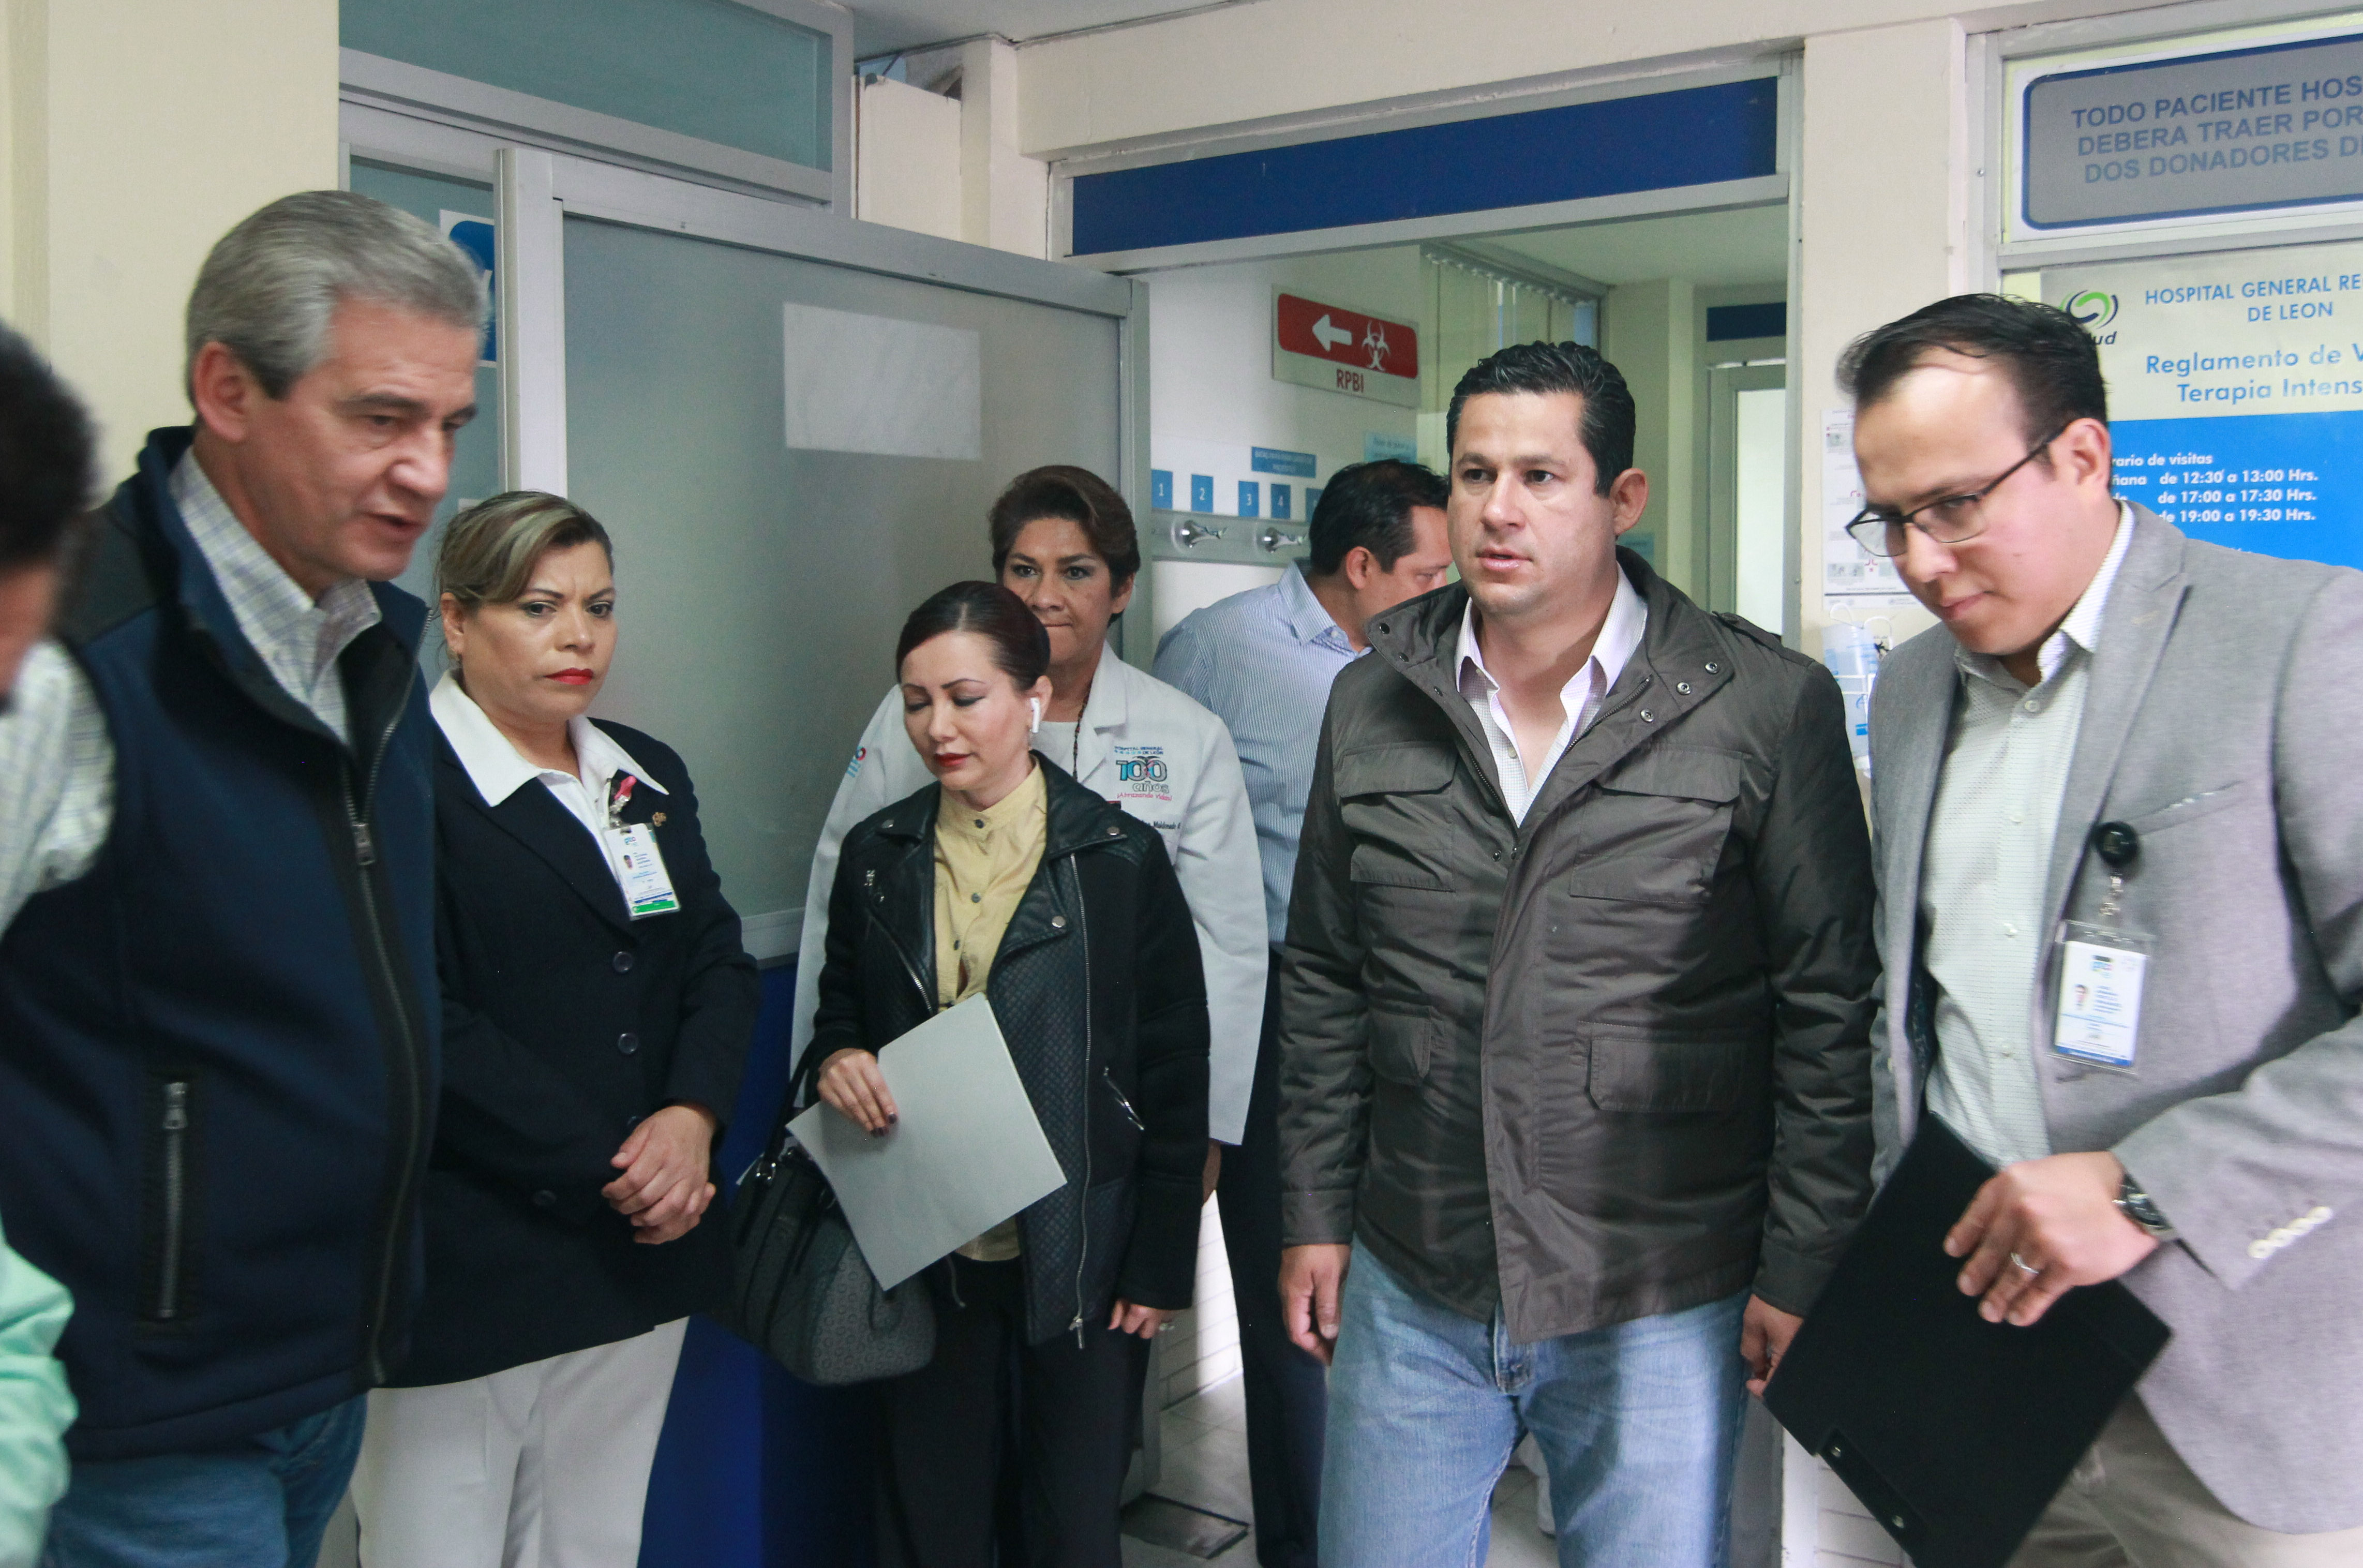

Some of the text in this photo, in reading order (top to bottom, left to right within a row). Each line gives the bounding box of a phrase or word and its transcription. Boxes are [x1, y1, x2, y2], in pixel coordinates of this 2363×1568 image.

[2071, 76, 2363, 129] TODO PACIENTE HOS
[2078, 106, 2363, 157] DEBERA TRAER POR
[2085, 135, 2363, 184] DOS DONADORES D
[2145, 274, 2363, 305] HOSPITAL GENERAL RE
[2248, 302, 2332, 322] DE LEON
[2147, 349, 2298, 378] Reglamento
[2309, 344, 2341, 364] de
[1336, 369, 1364, 393] RPBI
[2177, 379, 2363, 406] Terapia Intens
[2147, 454, 2165, 466] de
[2169, 452, 2213, 465] visitas
[2159, 472, 2178, 485] de
[2182, 470, 2223, 484] 12:30
[2227, 473, 2237, 483] a
[2242, 469, 2284, 483] 13:00
[2288, 468, 2319, 482] Hrs.
[1159, 483, 1163, 497] 1
[1200, 487, 1205, 500] 2
[2157, 488, 2317, 503] de 17:00 a 17:30 Hrs.
[1246, 494, 1252, 506] 3
[1278, 495, 1283, 507] 4
[2180, 510, 2220, 522] 19:00
[2224, 513, 2234, 522] a
[2239, 509, 2282, 521] 19:30
[2285, 508, 2316, 521] Hrs.
[1116, 759, 1167, 782] 100
[1132, 781, 1169, 794] años
